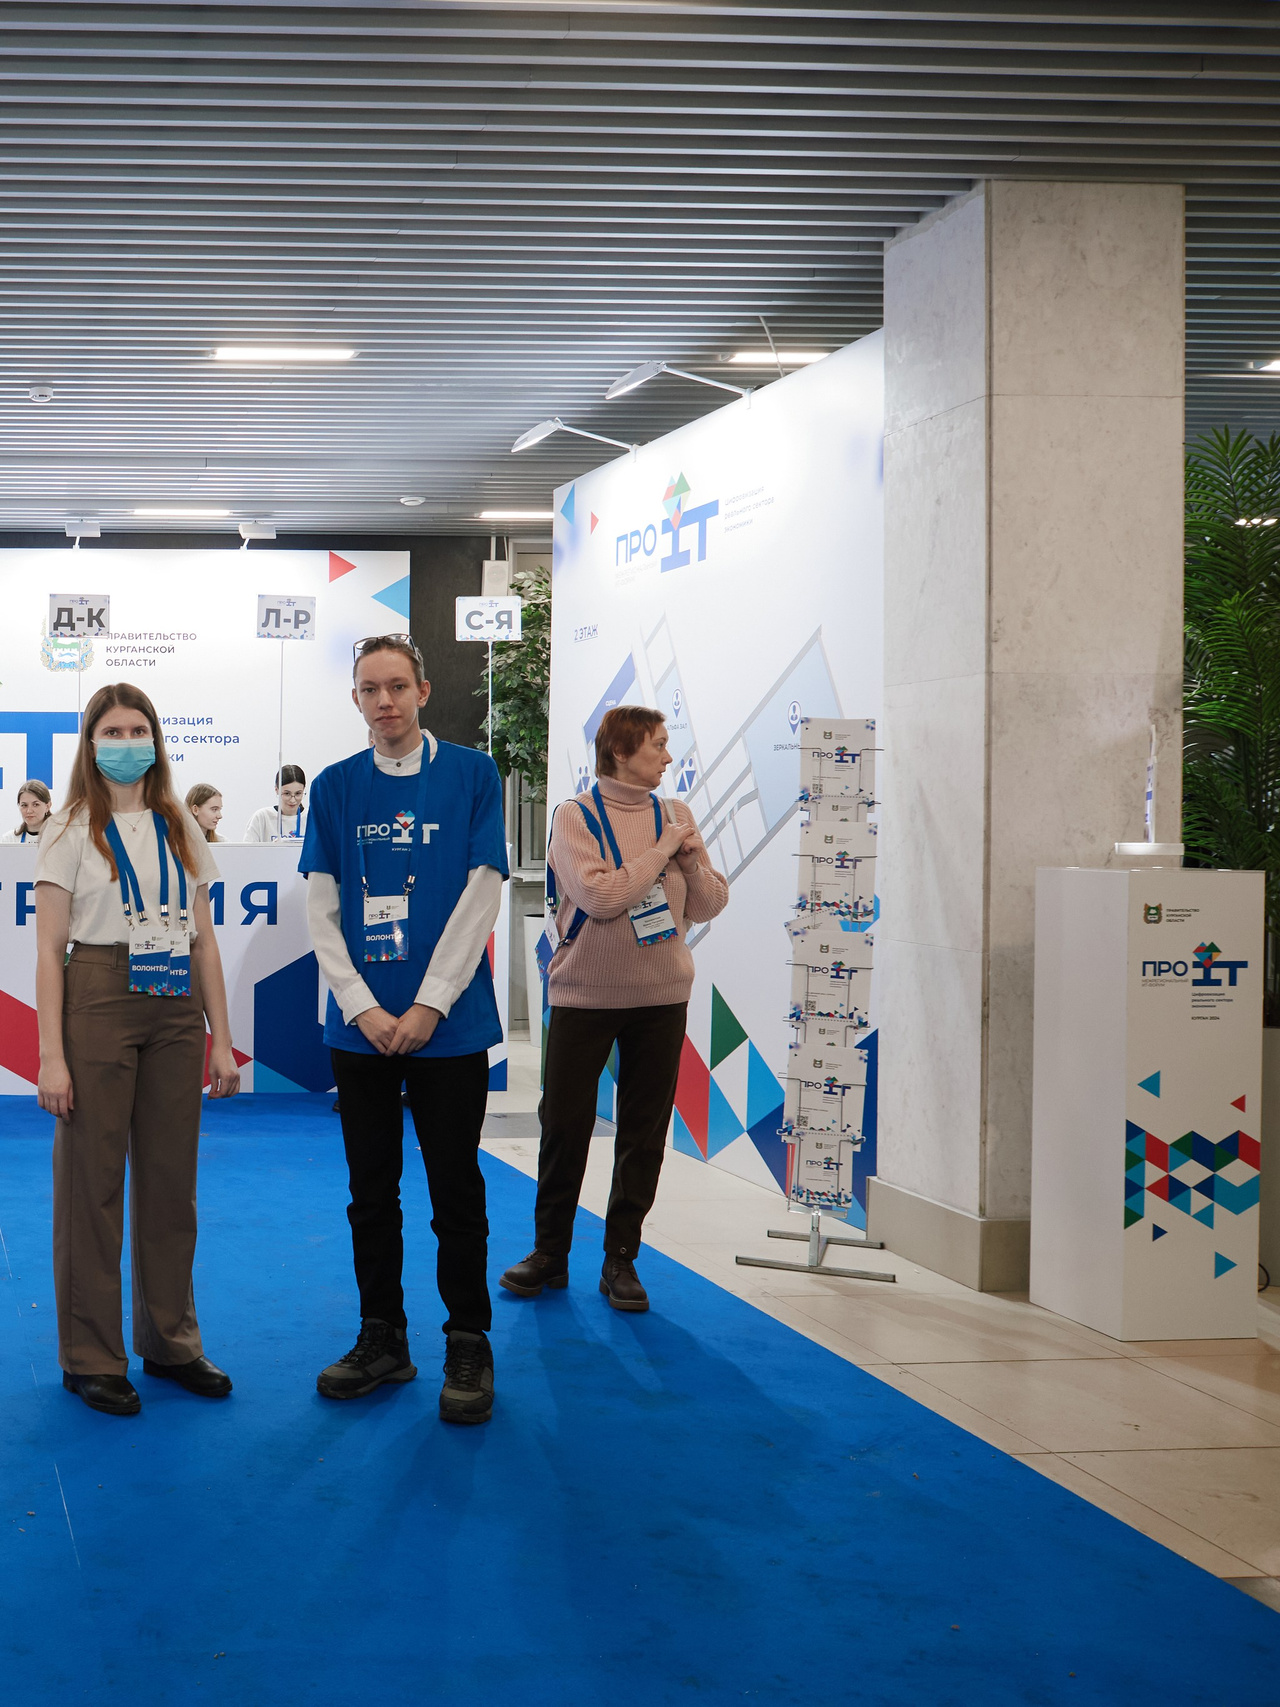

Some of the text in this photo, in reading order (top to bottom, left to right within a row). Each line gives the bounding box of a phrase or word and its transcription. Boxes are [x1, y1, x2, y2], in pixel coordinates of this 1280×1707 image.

[616, 524, 657, 566] ПРО
[53, 608, 105, 631] Д-К
[262, 608, 311, 629] Л-Р
[465, 610, 512, 630] С-Я
[574, 624, 598, 641] 2 ЭТАЖ
[106, 644, 175, 653] КУРГАНСКОЙ
[106, 658, 156, 666] ОБЛАСТИ
[183, 735, 240, 746] сектора
[1142, 960, 1248, 986] ПРО IT
